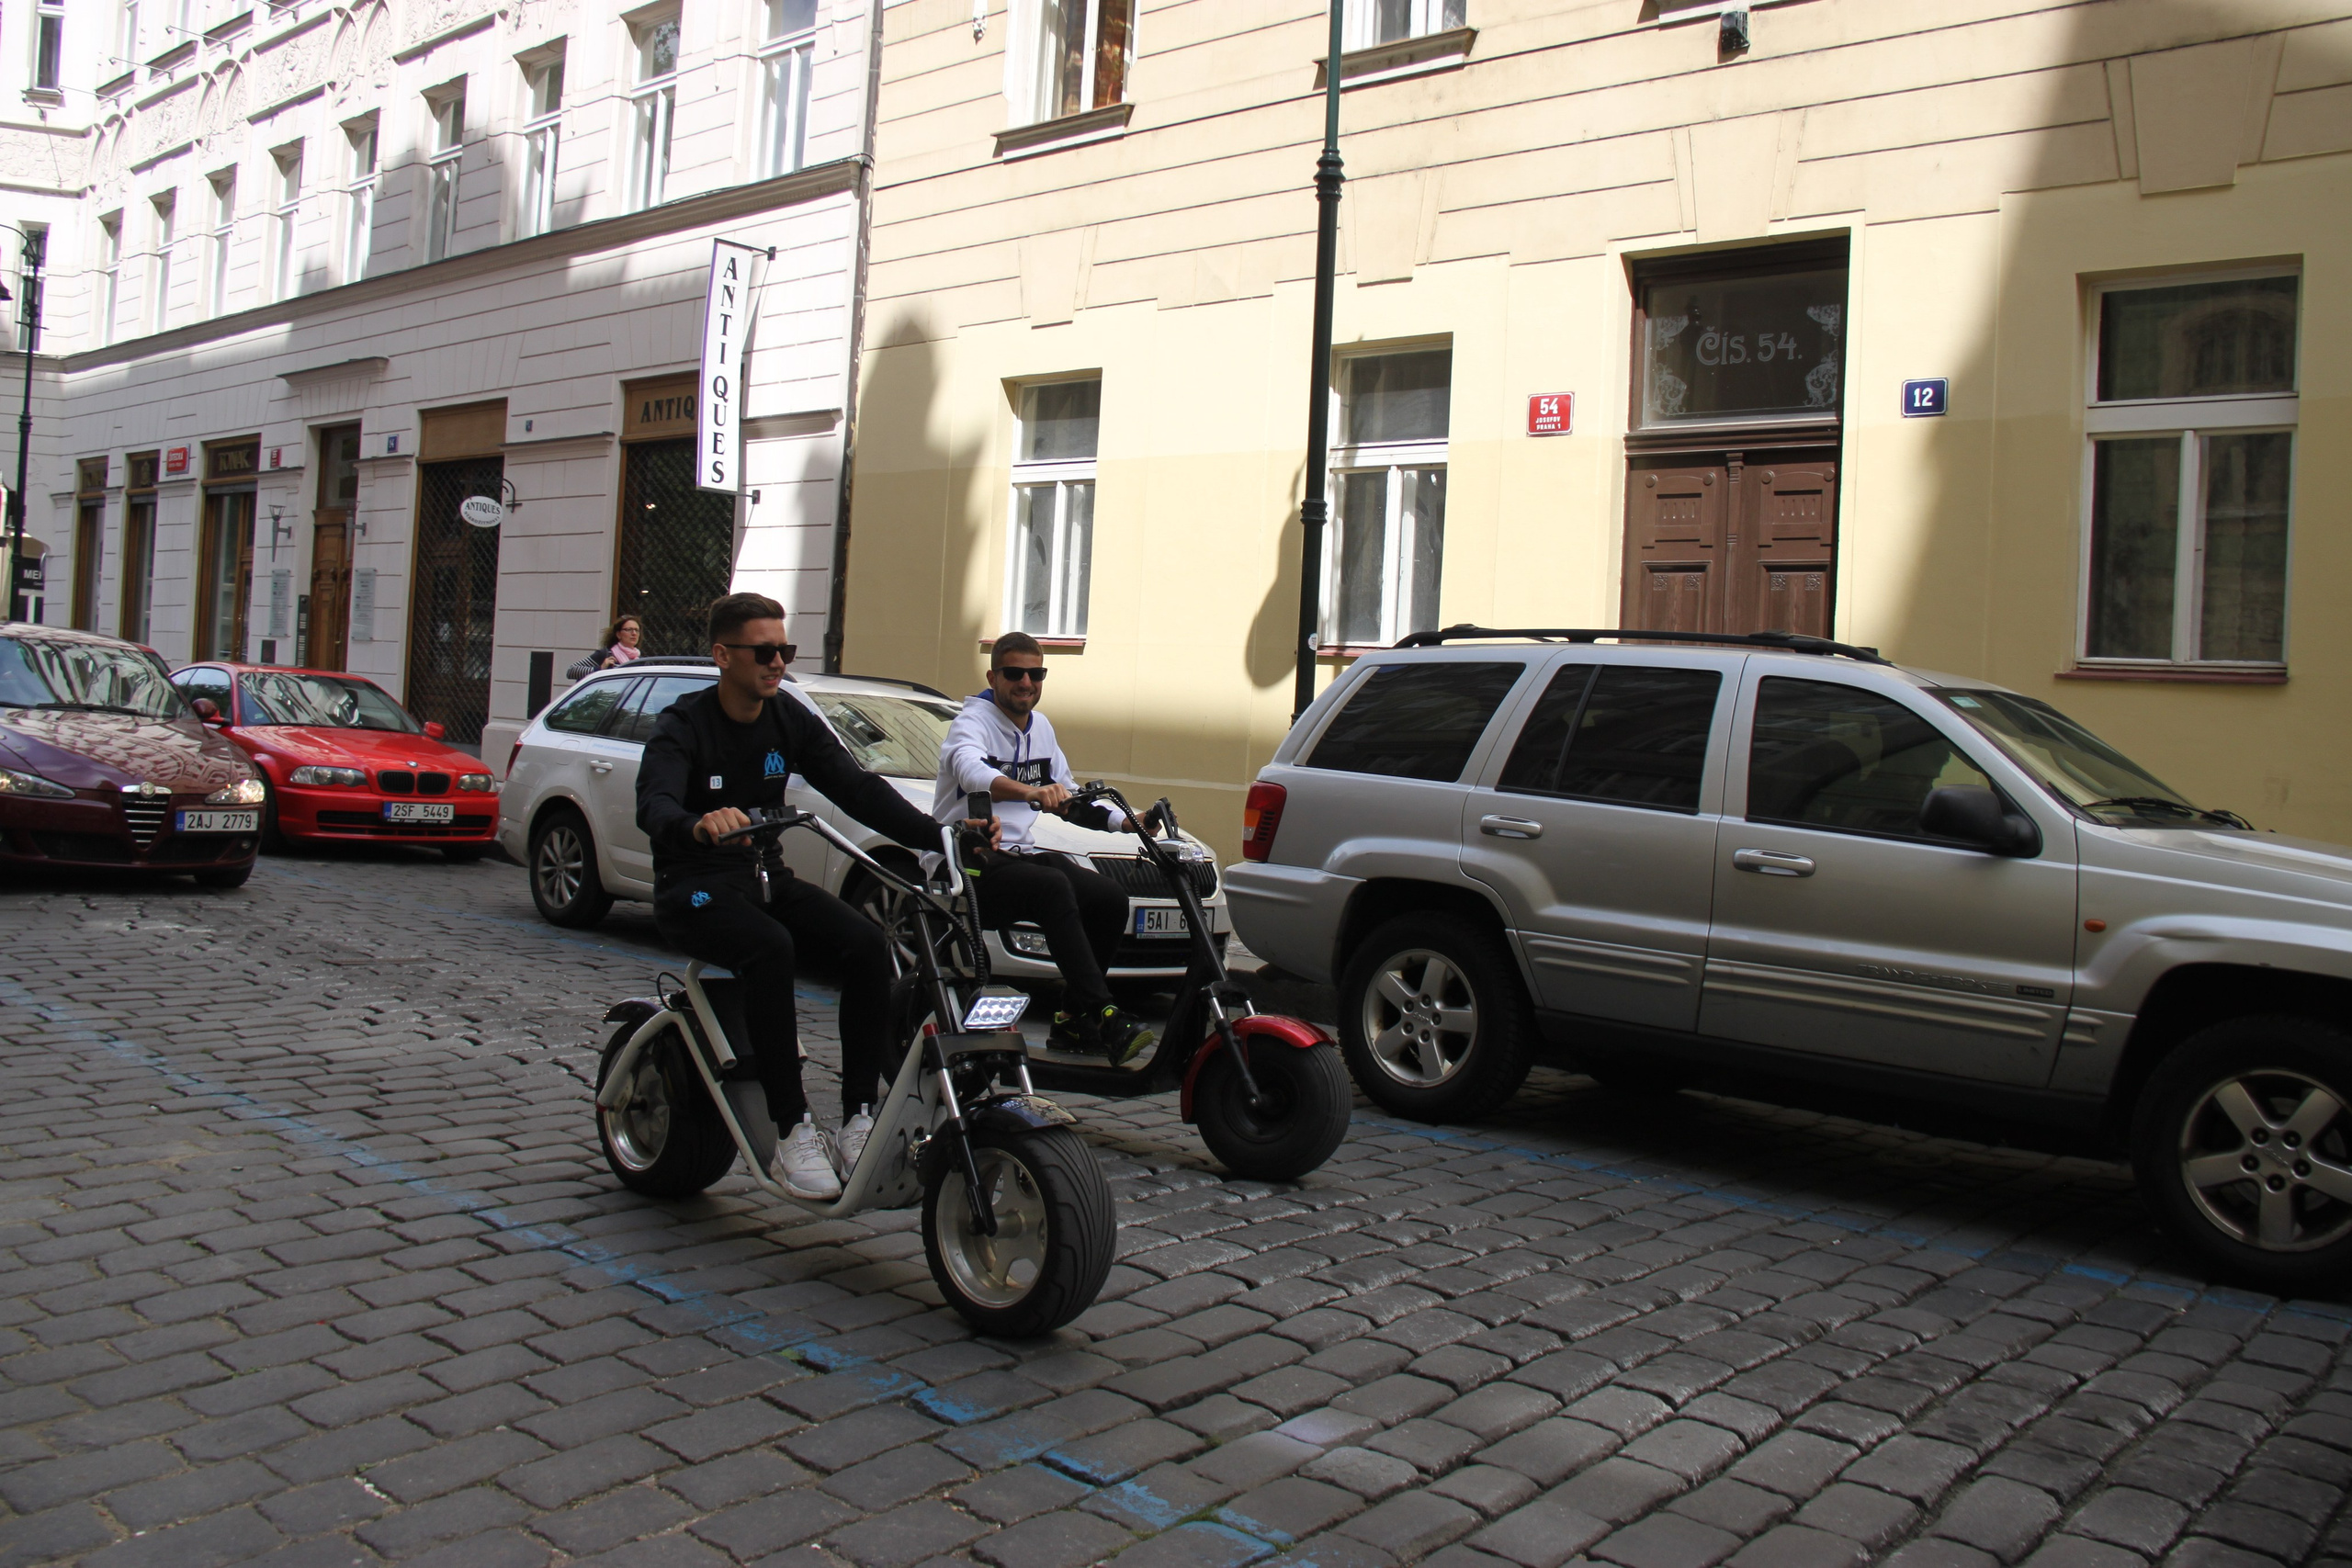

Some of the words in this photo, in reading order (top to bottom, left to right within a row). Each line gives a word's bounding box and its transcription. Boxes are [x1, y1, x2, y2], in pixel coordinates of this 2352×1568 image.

[1757, 332, 1803, 362] 54.
[710, 257, 738, 483] ANTIQUES
[1540, 397, 1558, 415] 54
[1914, 387, 1933, 407] 12
[640, 395, 695, 423] ANTIQ
[465, 502, 501, 514] ANTIQUES
[711, 778, 721, 787] 13
[393, 805, 415, 817] 2SF
[423, 806, 449, 818] 5449
[187, 814, 213, 829] 2AJ
[222, 814, 252, 829] 2779
[1918, 972, 2010, 992] CHEROKEE
[2018, 986, 2053, 997] LIMITED
